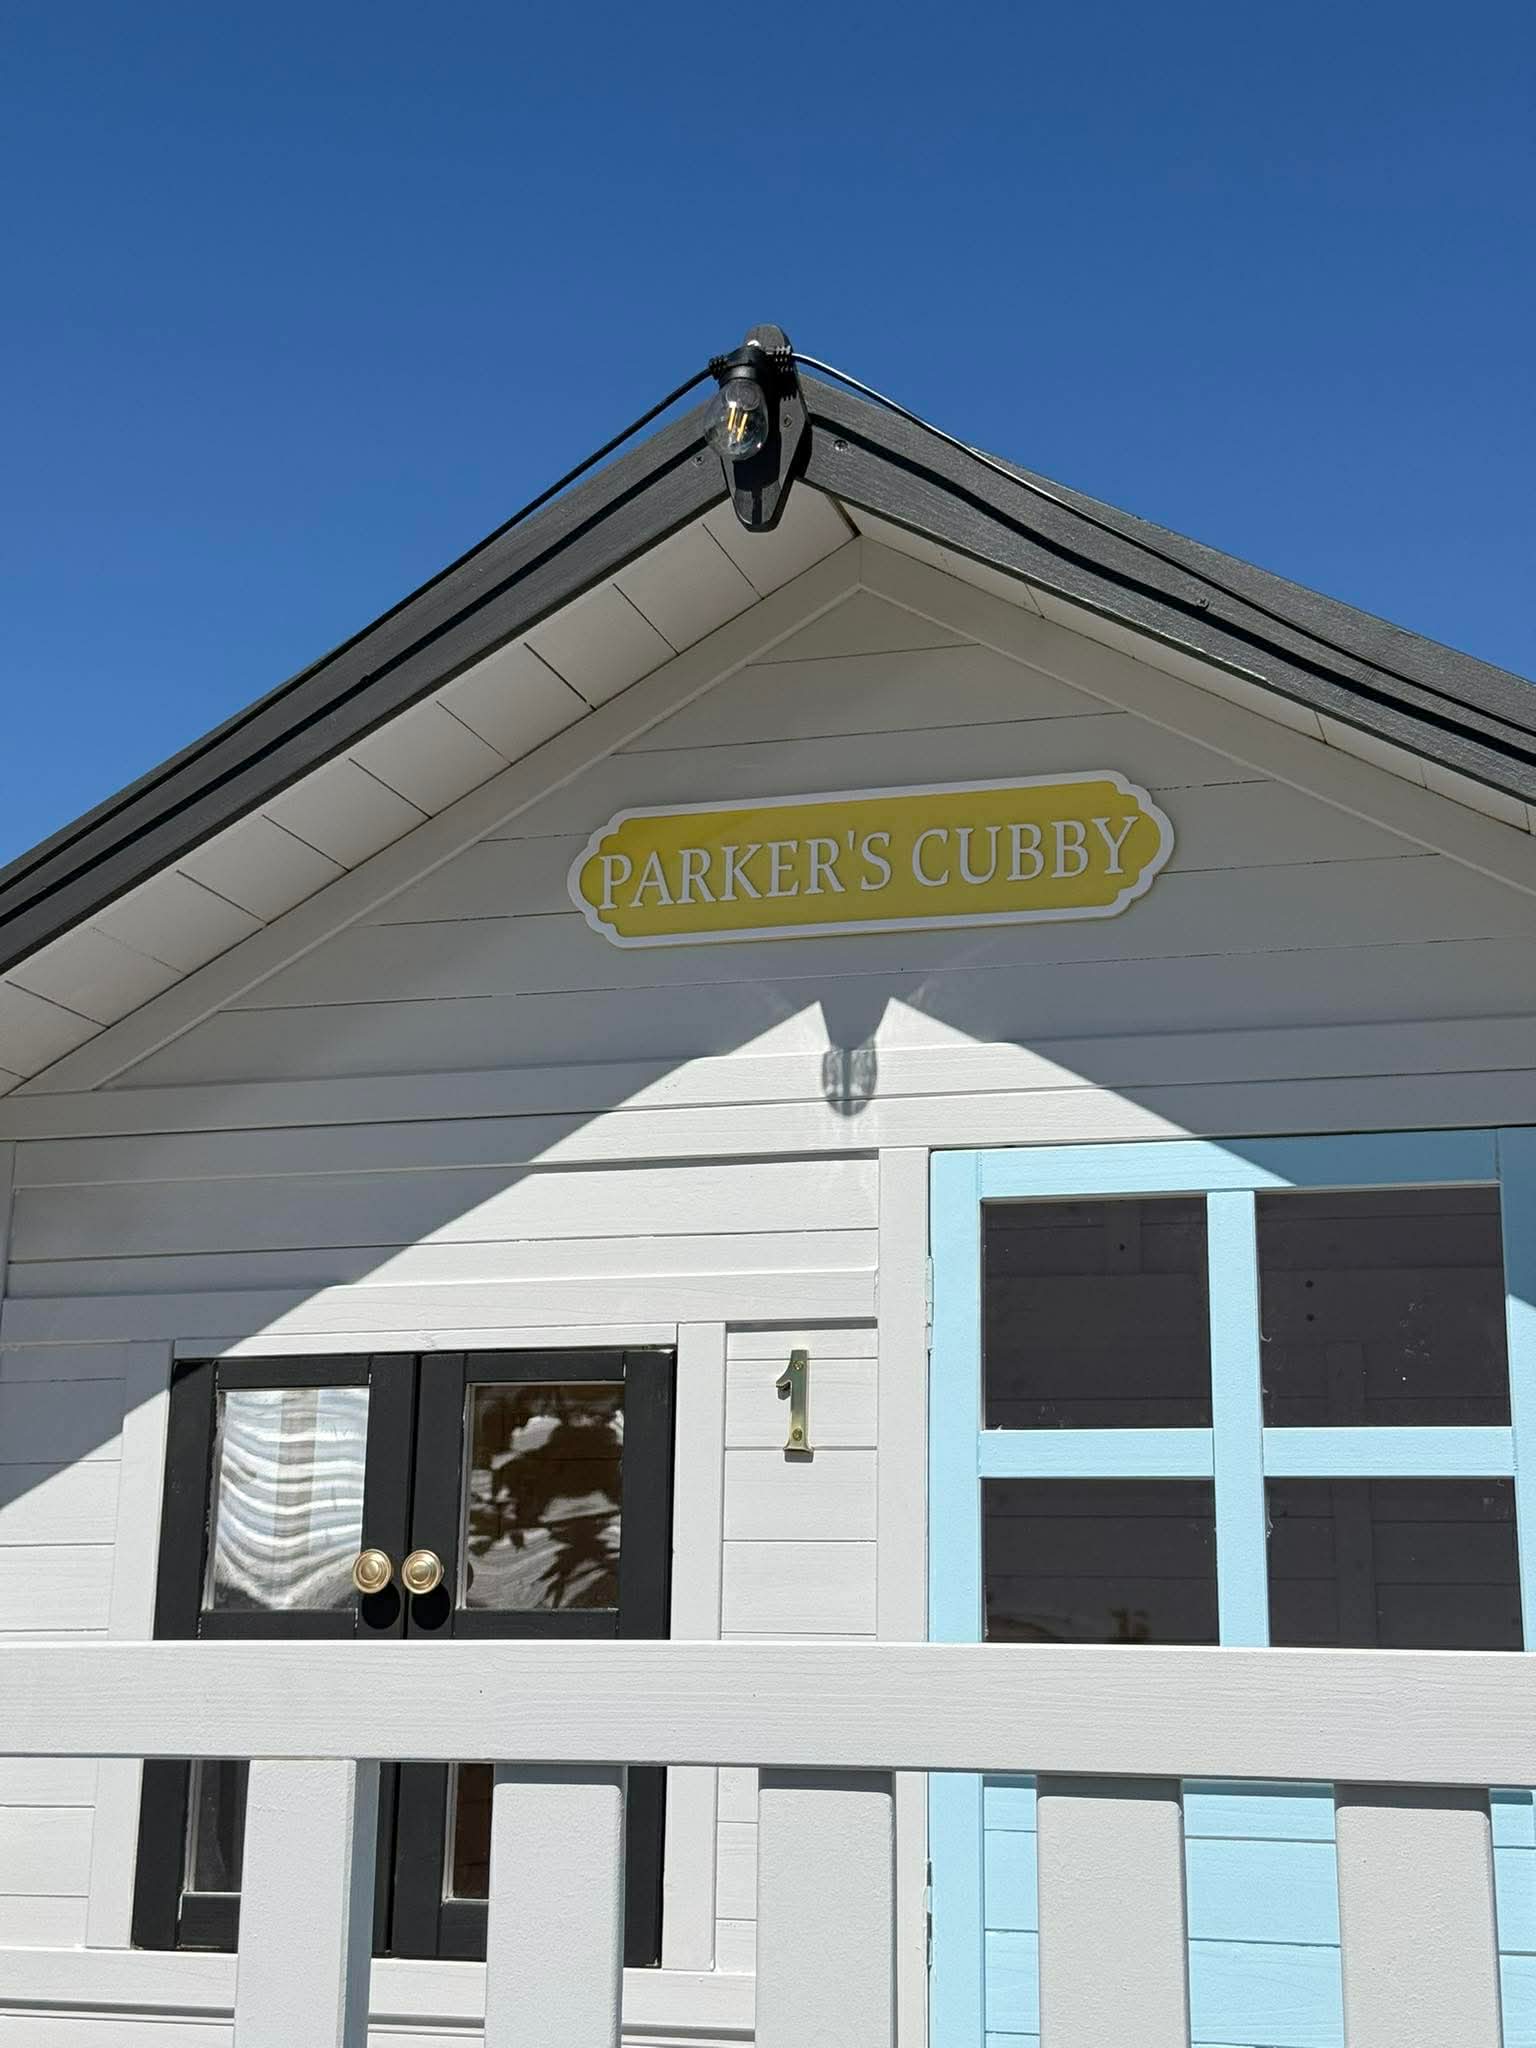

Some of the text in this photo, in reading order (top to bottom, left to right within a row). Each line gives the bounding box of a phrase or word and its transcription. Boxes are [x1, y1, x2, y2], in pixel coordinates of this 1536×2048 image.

[599, 815, 1139, 910] PARKER'S CUBBY
[776, 1349, 814, 1452] 1
